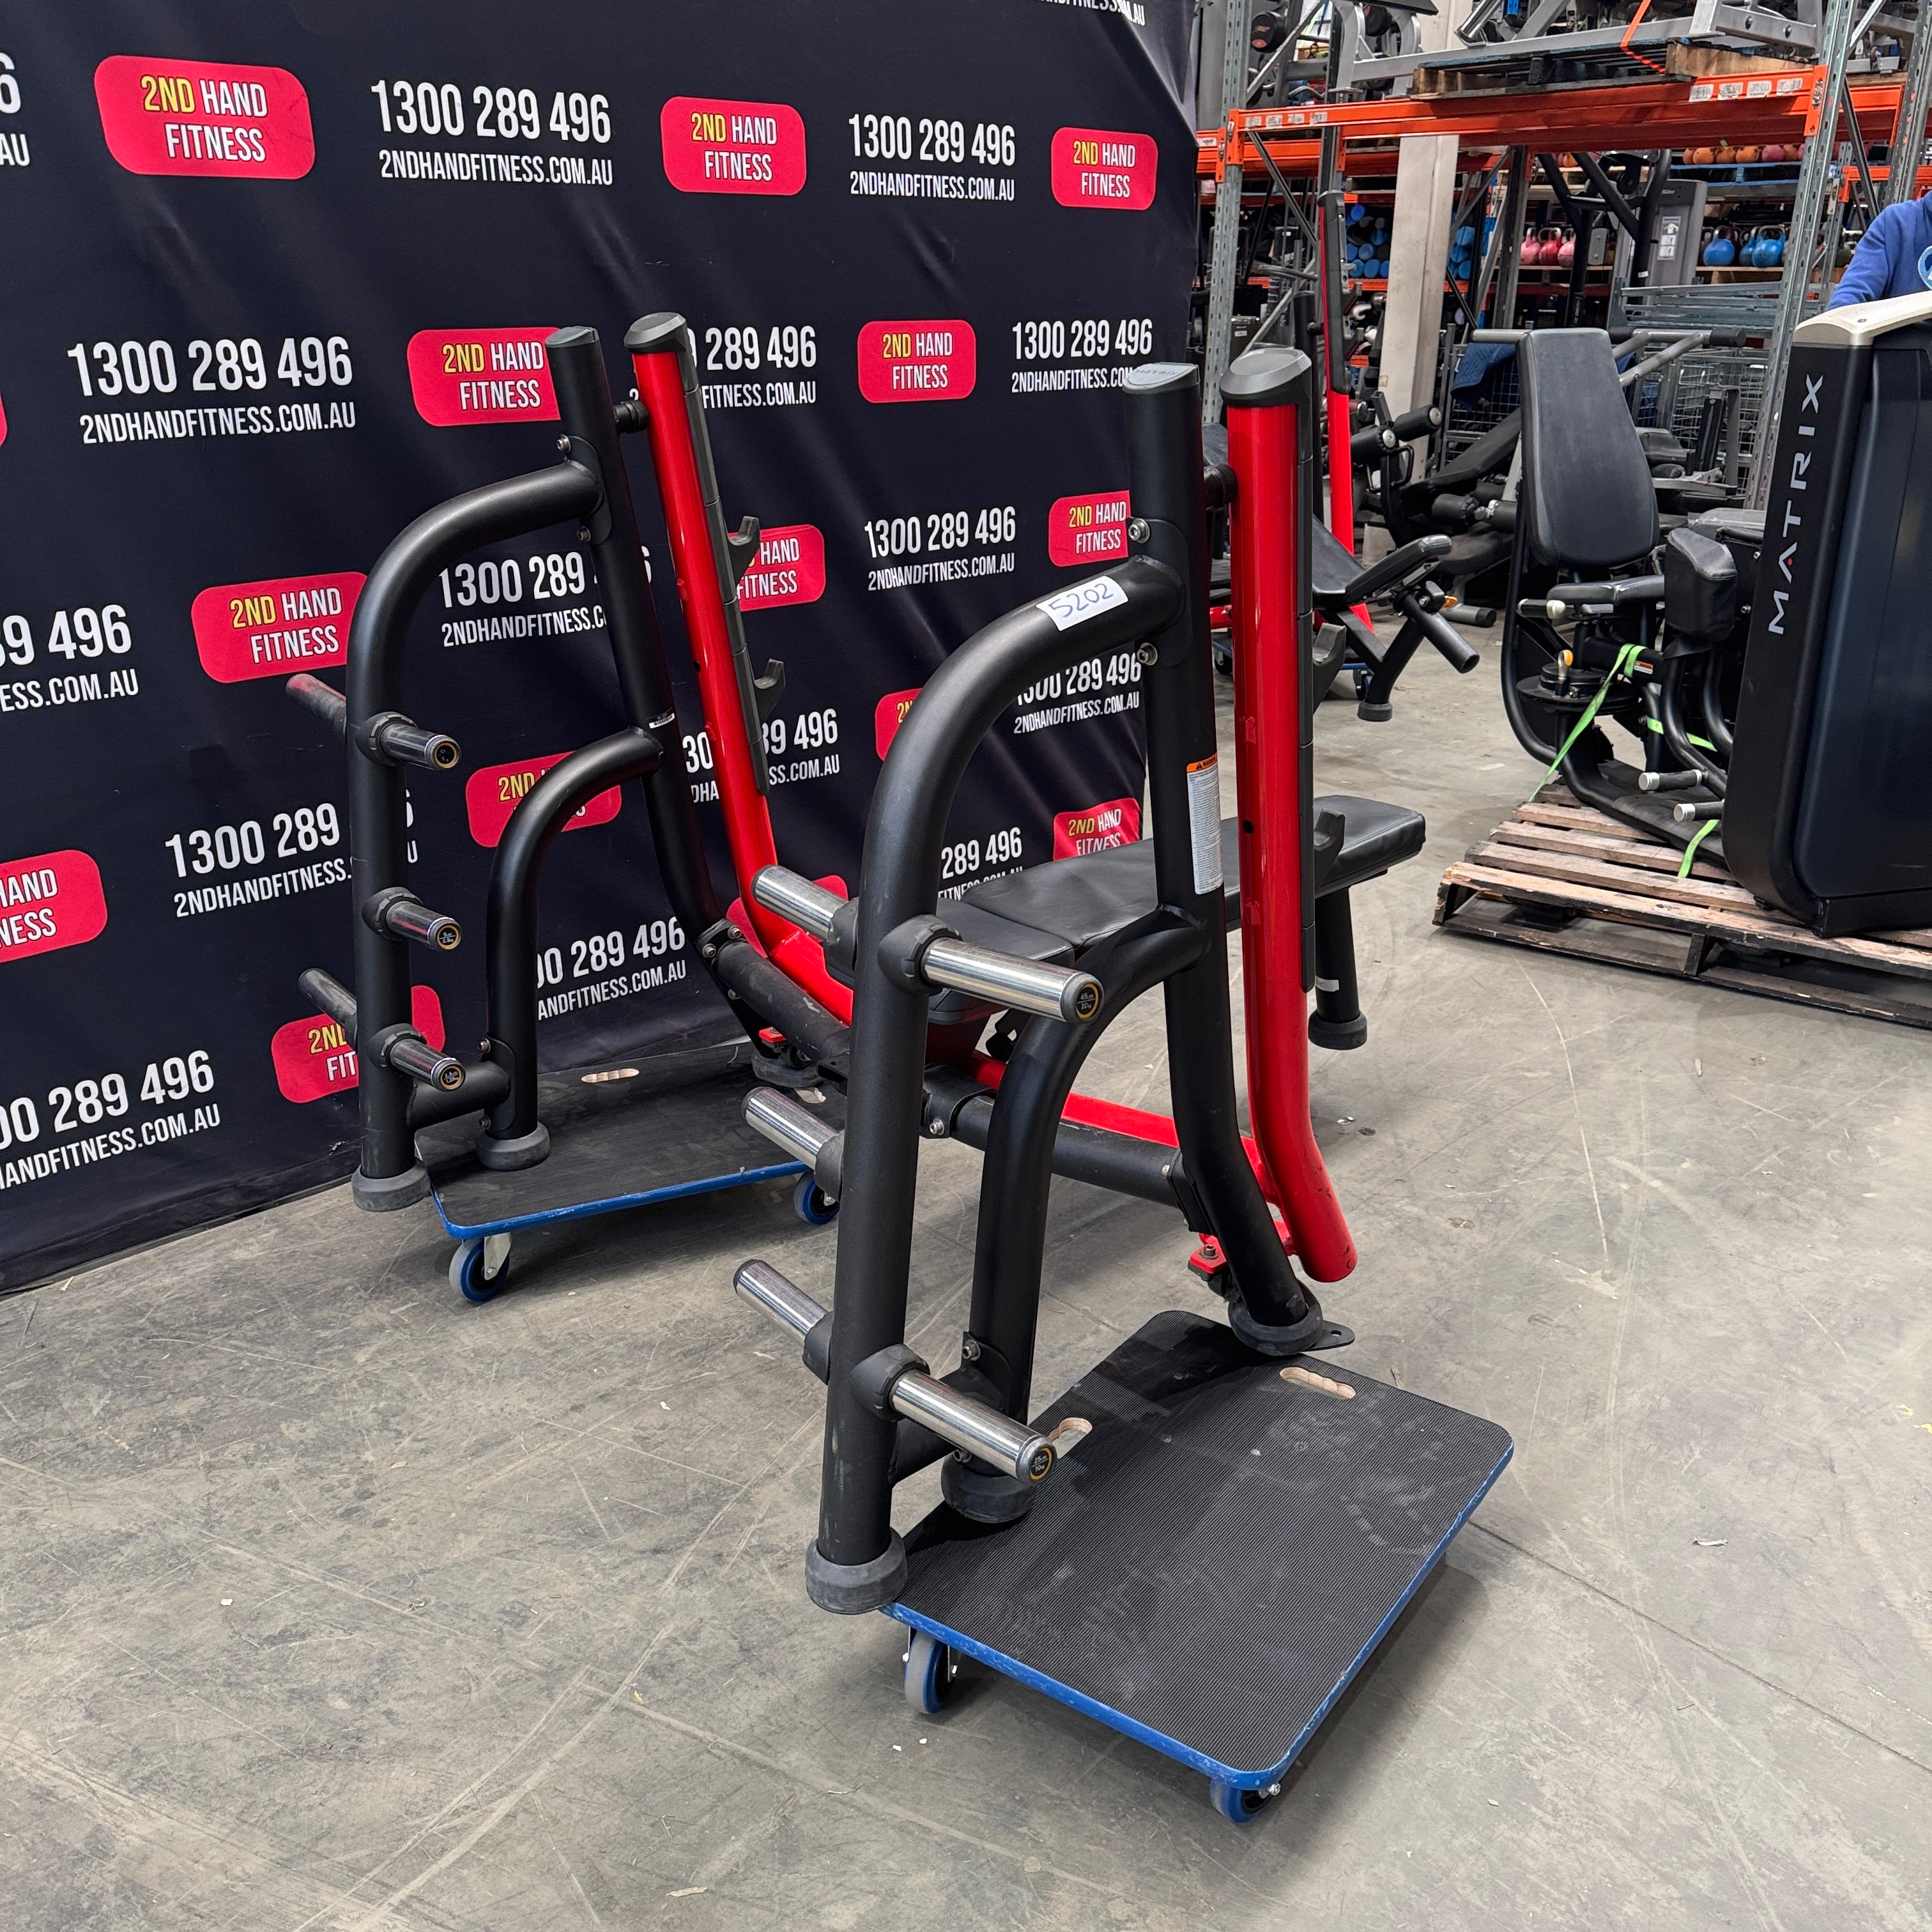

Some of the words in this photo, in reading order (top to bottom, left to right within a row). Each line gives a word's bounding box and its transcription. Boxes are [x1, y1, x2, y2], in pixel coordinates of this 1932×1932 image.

[141, 75, 195, 113] 2ND
[199, 79, 268, 117] HAND
[371, 79, 464, 136] 1300
[473, 86, 540, 139] 289
[549, 91, 611, 144] 496
[165, 123, 266, 162] FITNESS
[691, 112, 726, 142] 2ND
[731, 115, 777, 145] HAND
[848, 114, 912, 160] 1300
[919, 118, 965, 163] 289
[971, 123, 1015, 166] 496
[379, 150, 613, 186] 2NDHANDFITNESS.COM.AU
[704, 151, 772, 181] FITNESS
[1073, 140, 1098, 165] 2ND
[1102, 142, 1135, 167] HAND
[850, 171, 1015, 201] 2NDHANDFITNESS.COM.AU
[1081, 172, 1130, 198] FITNESS
[443, 344, 485, 373] 2ND
[490, 342, 544, 371] HAND
[705, 326, 760, 371] 289
[767, 325, 816, 369] 496
[882, 334, 911, 358] 2ND
[916, 332, 953, 357] HAND
[1012, 320, 1065, 360] 1300
[1070, 319, 1110, 357] 289
[1114, 318, 1153, 355] 496
[67, 340, 177, 397] 1300
[188, 338, 267, 391] 289
[277, 336, 353, 387] 496
[893, 364, 948, 390] FITNESS
[459, 379, 540, 410] FITNESS
[79, 401, 356, 444] 2NDHANDFITNESS.COM.AU
[1069, 505, 1092, 528] 2ND
[1096, 501, 1126, 525] HAND
[1768, 374, 1823, 634] MATRIX
[760, 538, 800, 565] HAND
[864, 518, 921, 558] 1300
[927, 511, 969, 551] 289
[974, 506, 1016, 544] 496
[1076, 528, 1121, 554] FITNESS
[438, 559, 523, 608] 1300
[528, 551, 585, 600] 289
[868, 552, 1015, 591] 2NDHANDFITNESS.COM.AU
[230, 595, 276, 628] 2ND
[281, 588, 342, 621] HAND
[1048, 582, 1114, 618] 5202
[48, 604, 132, 660] 496
[250, 625, 339, 663] FITNESS
[441, 605, 607, 647] 2NDHANDFITNESS.C
[1065, 658, 1103, 695] 289
[1106, 650, 1142, 686] 496
[793, 708, 838, 749] 496
[1013, 689, 1139, 734] 2NDHANDFITNESS.COM.AU
[165, 820, 265, 878] 1300
[273, 802, 340, 858] 289
[1068, 817, 1095, 836] 2ND
[1097, 808, 1122, 832] HAND
[941, 839, 980, 880] 289
[985, 827, 1022, 864] 496
[571, 931, 625, 978] 289
[632, 916, 685, 958] 496
[538, 960, 686, 1021] ANDFITNESS.COM.AU
[48, 1073, 128, 1133] 289
[140, 1050, 214, 1105] 496
[0, 1103, 220, 1190] ANDFITNESS.COM.AU
